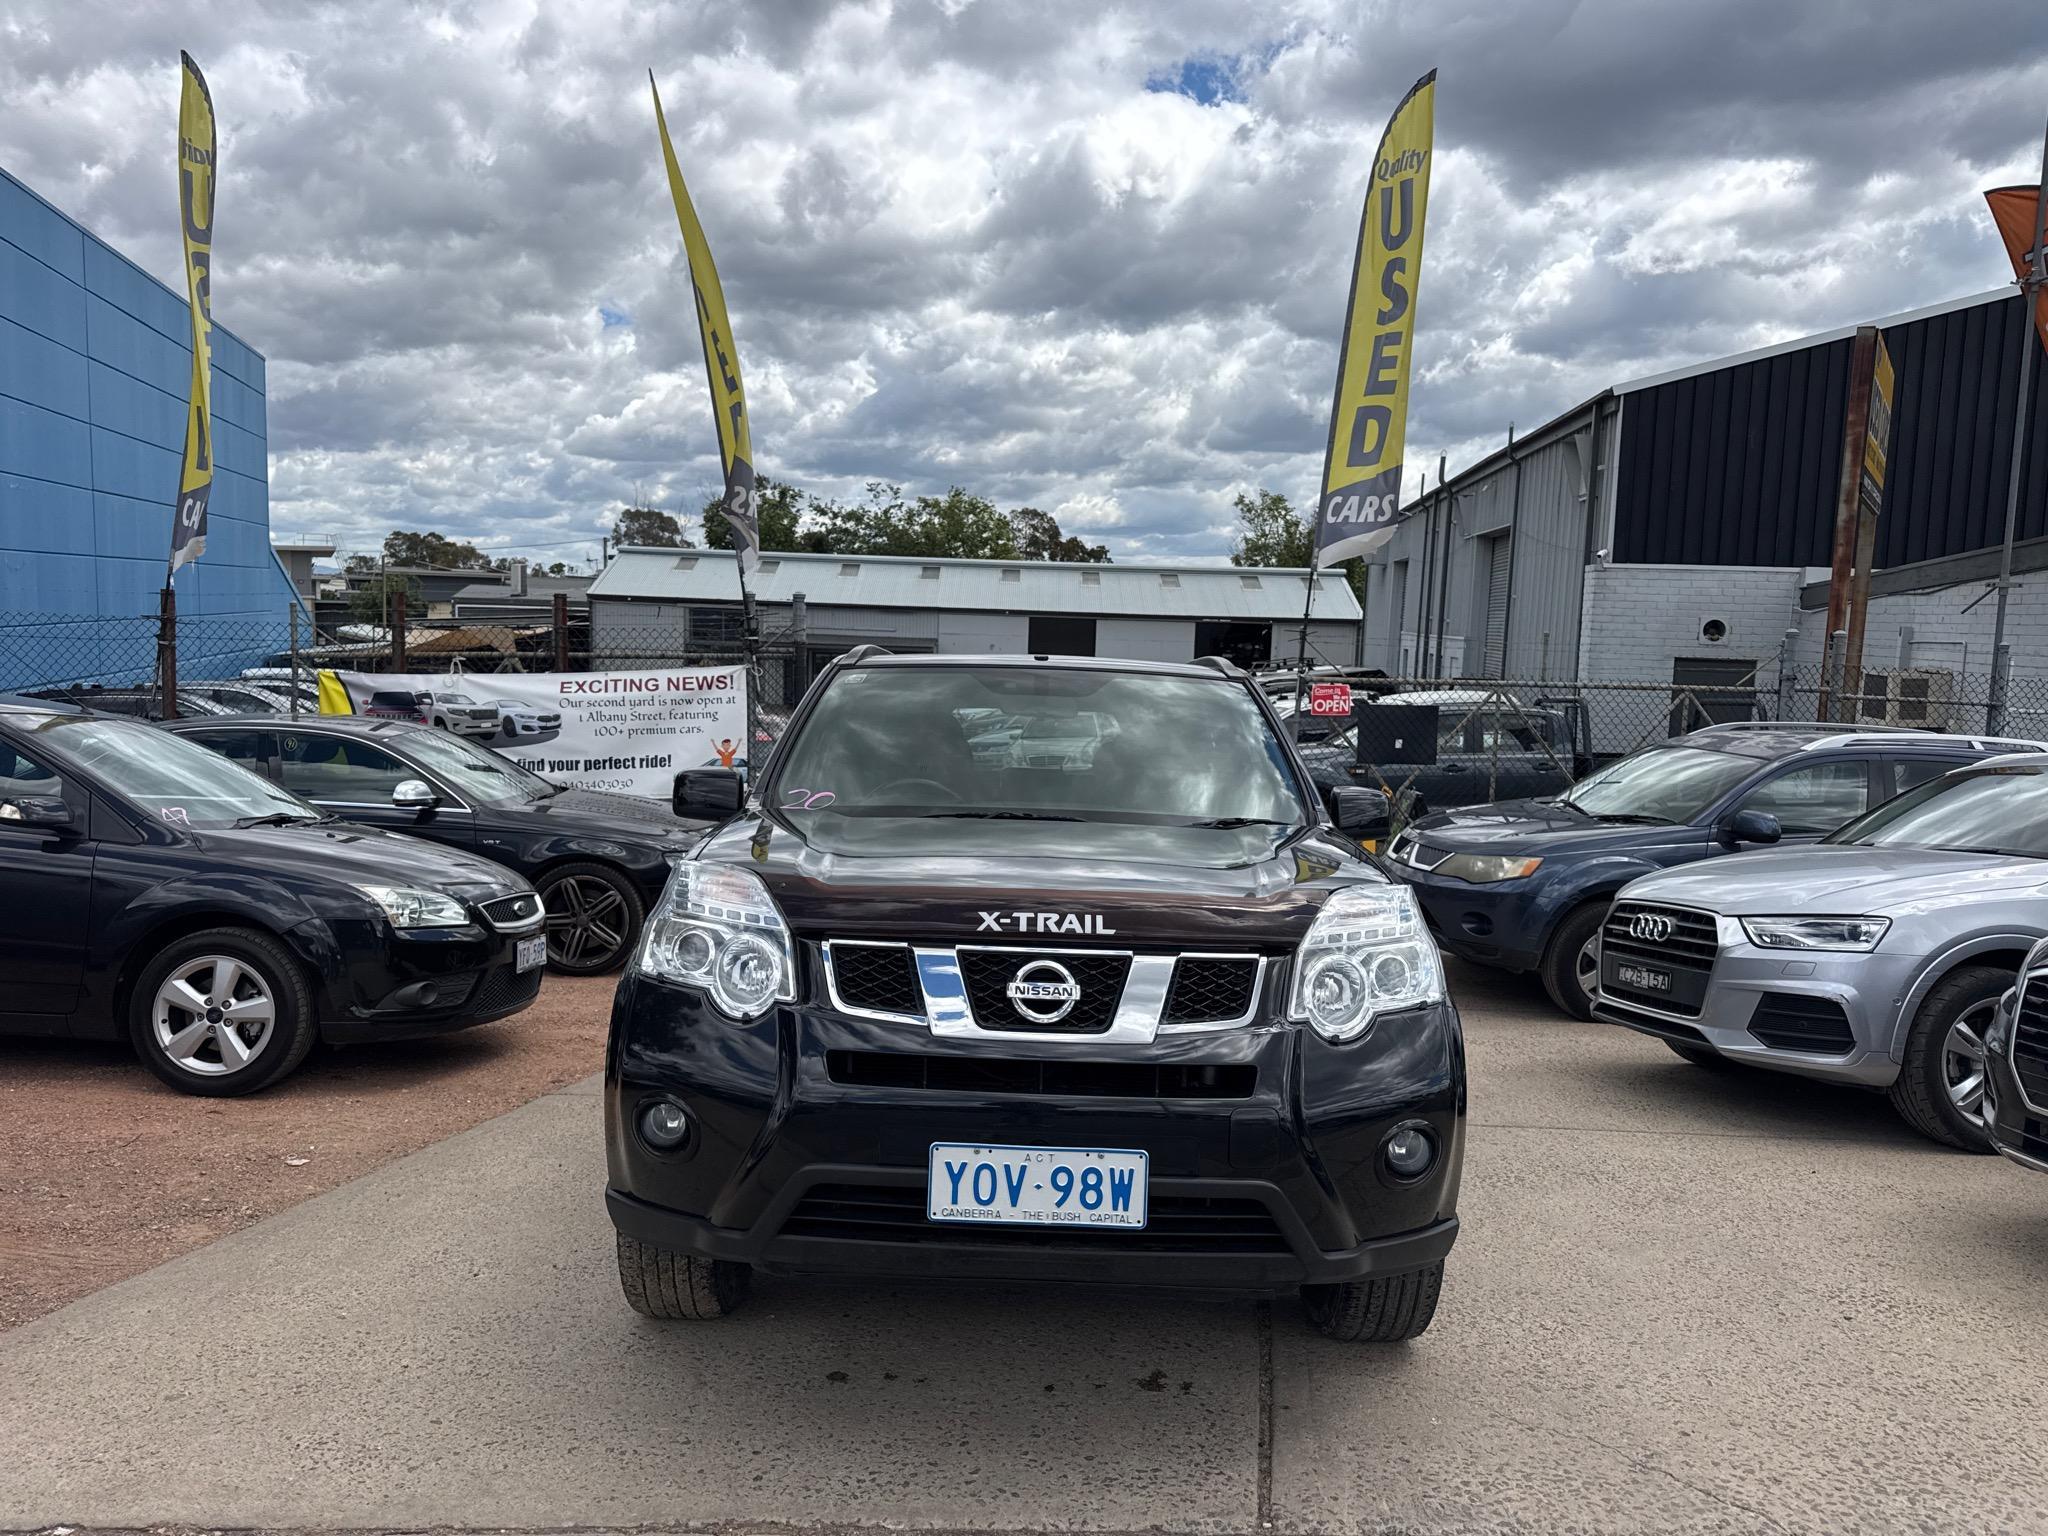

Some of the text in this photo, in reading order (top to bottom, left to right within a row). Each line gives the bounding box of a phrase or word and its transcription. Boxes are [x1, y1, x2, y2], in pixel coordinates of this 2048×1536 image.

[1346, 177, 1414, 469] USED
[1326, 494, 1395, 524] CARS
[560, 675, 734, 693] EXCITING NEWS!
[559, 694, 736, 710] Our second yard is now open at
[1314, 700, 1349, 712] OPEN
[586, 710, 627, 725] Albany
[669, 708, 719, 722] featuring
[594, 723, 705, 739] 100+ premium cars.
[548, 759, 580, 773] your
[584, 756, 636, 772] perfect
[639, 754, 672, 769] ride!
[780, 788, 836, 811] 20
[976, 911, 1117, 935] X-TRAIL
[1014, 985, 1073, 997] NISSAN
[1024, 1153, 1056, 1163] ACT
[941, 1207, 1002, 1219] CANBERRA
[1022, 1210, 1043, 1220] THE
[1052, 1211, 1081, 1221] BUSH
[1089, 1213, 1133, 1224] CAPITAL
